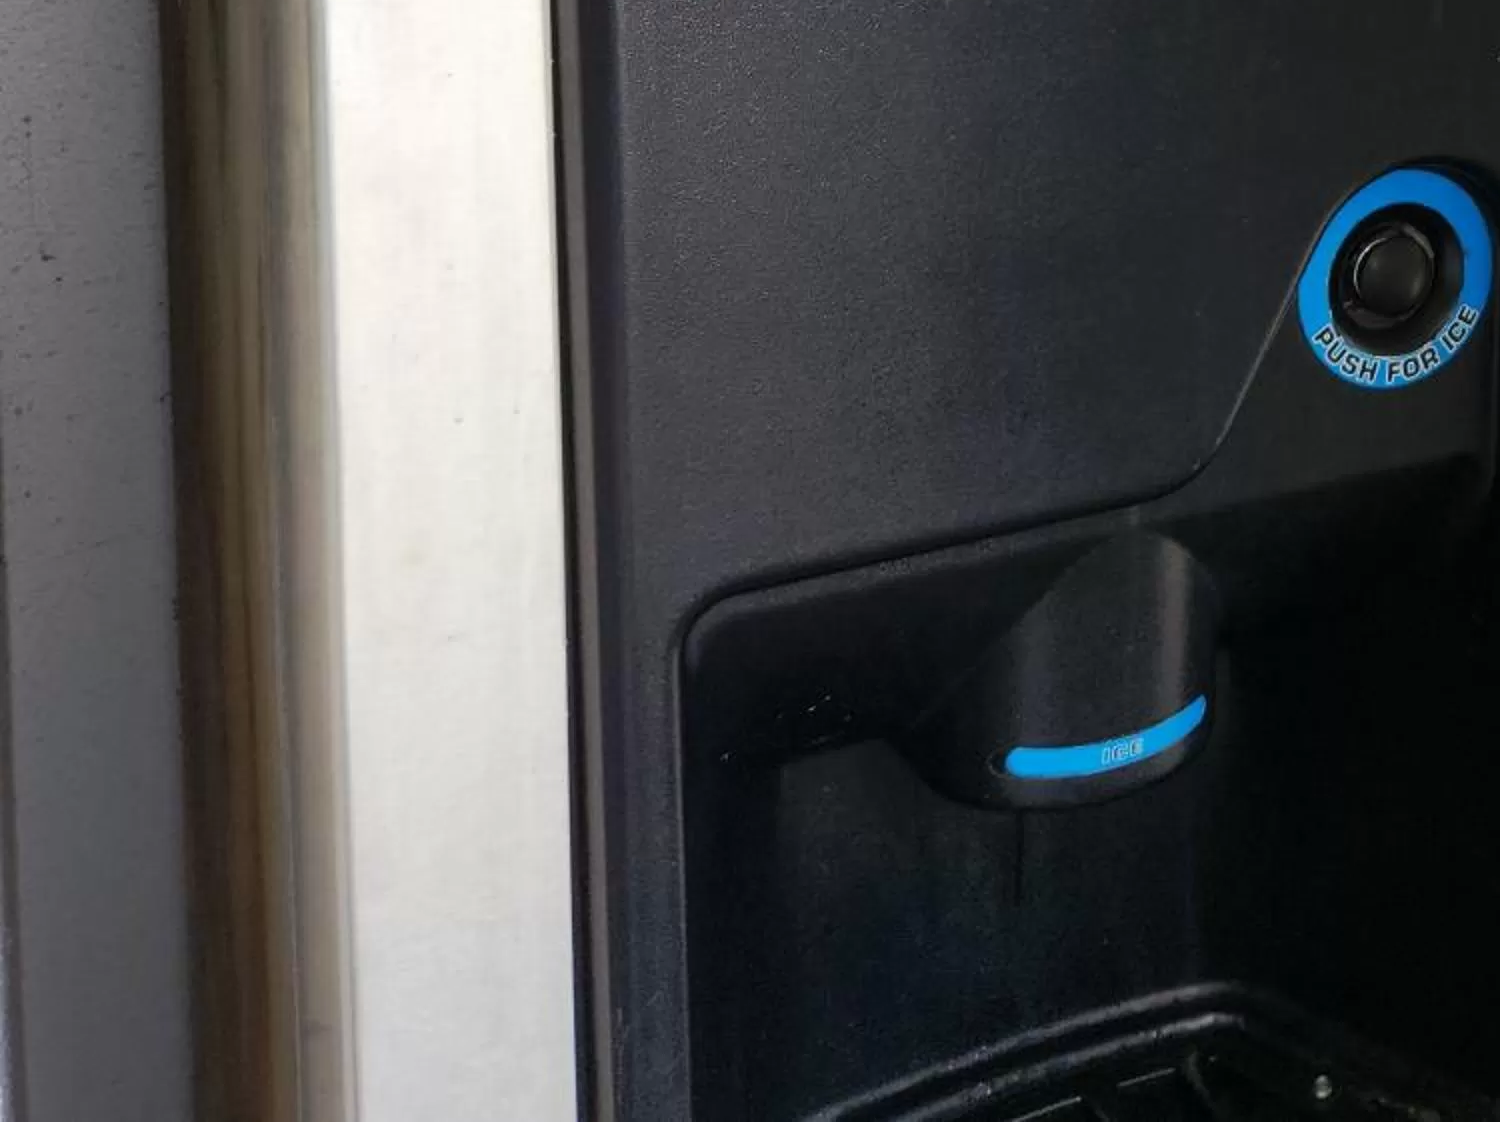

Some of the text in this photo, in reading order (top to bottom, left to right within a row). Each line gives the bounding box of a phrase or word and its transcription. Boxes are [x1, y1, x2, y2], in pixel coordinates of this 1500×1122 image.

[1313, 303, 1479, 383] PUSH FOR ICE
[1101, 734, 1144, 765] ICE
